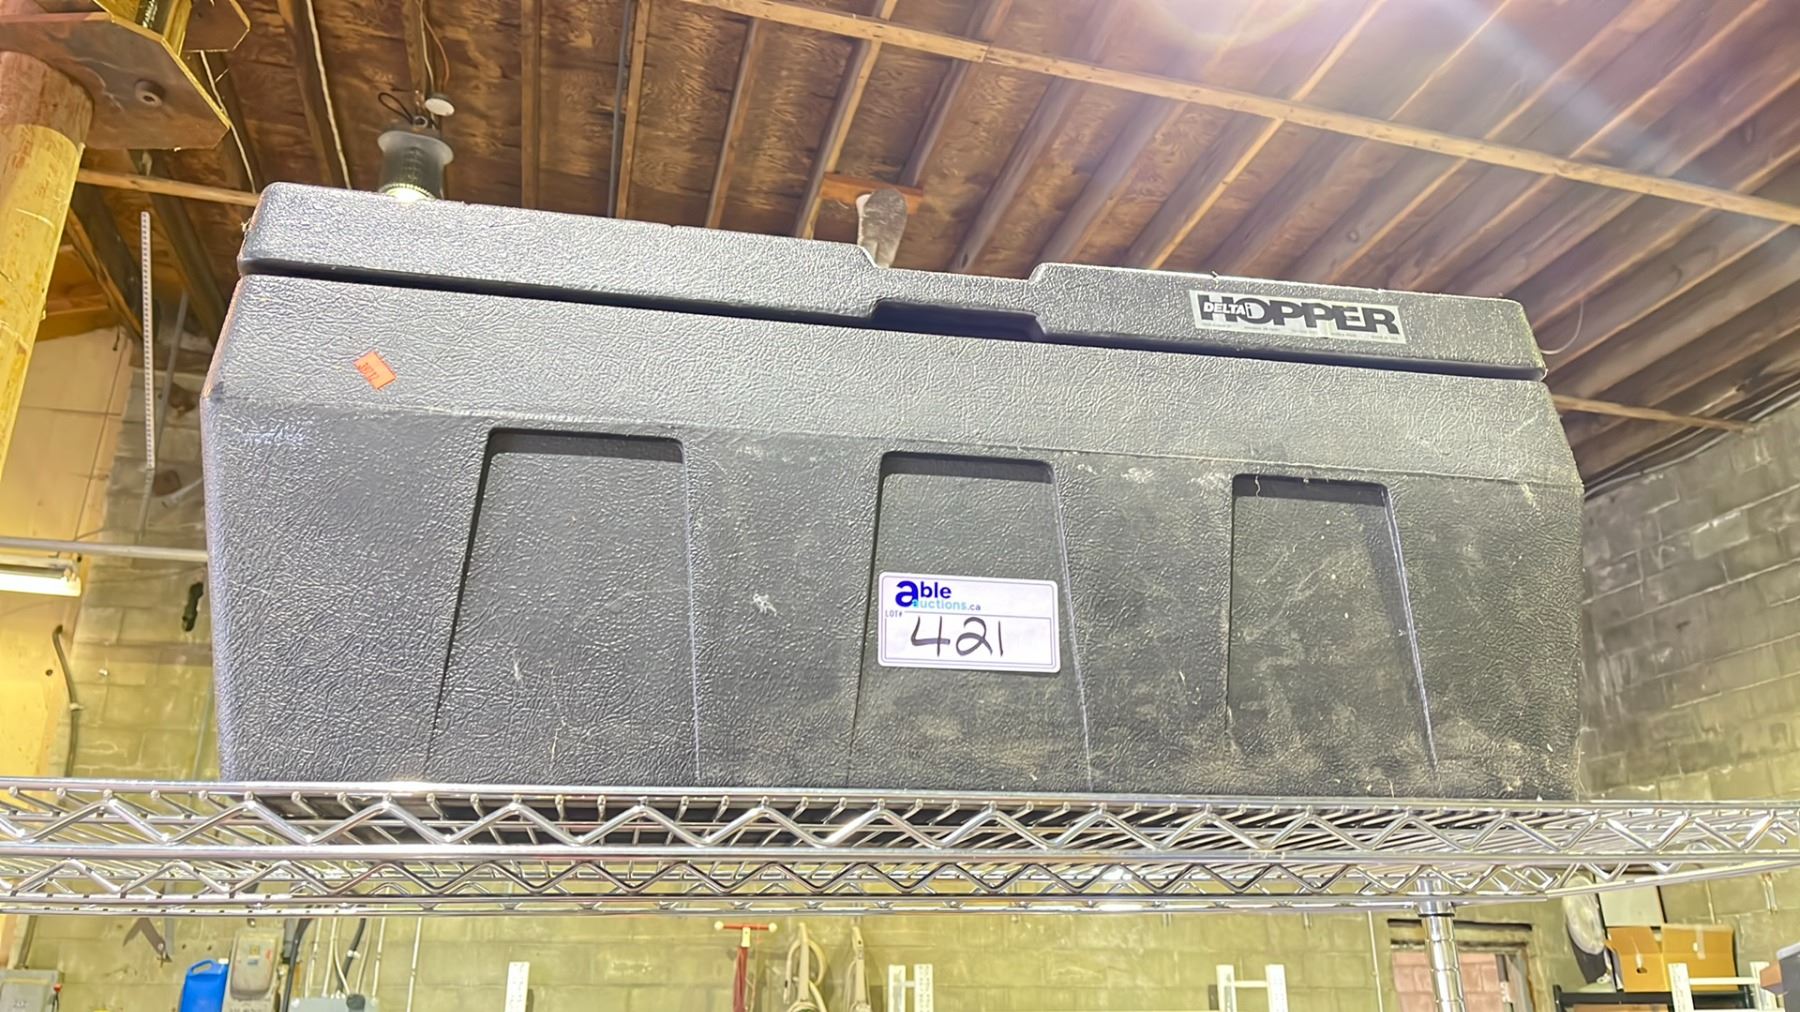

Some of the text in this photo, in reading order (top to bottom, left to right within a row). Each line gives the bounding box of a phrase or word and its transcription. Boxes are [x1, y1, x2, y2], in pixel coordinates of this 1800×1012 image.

[1197, 294, 1400, 335] HOPPER
[1203, 301, 1246, 316] DELTA
[895, 580, 952, 608] able
[911, 616, 1004, 657] 421
